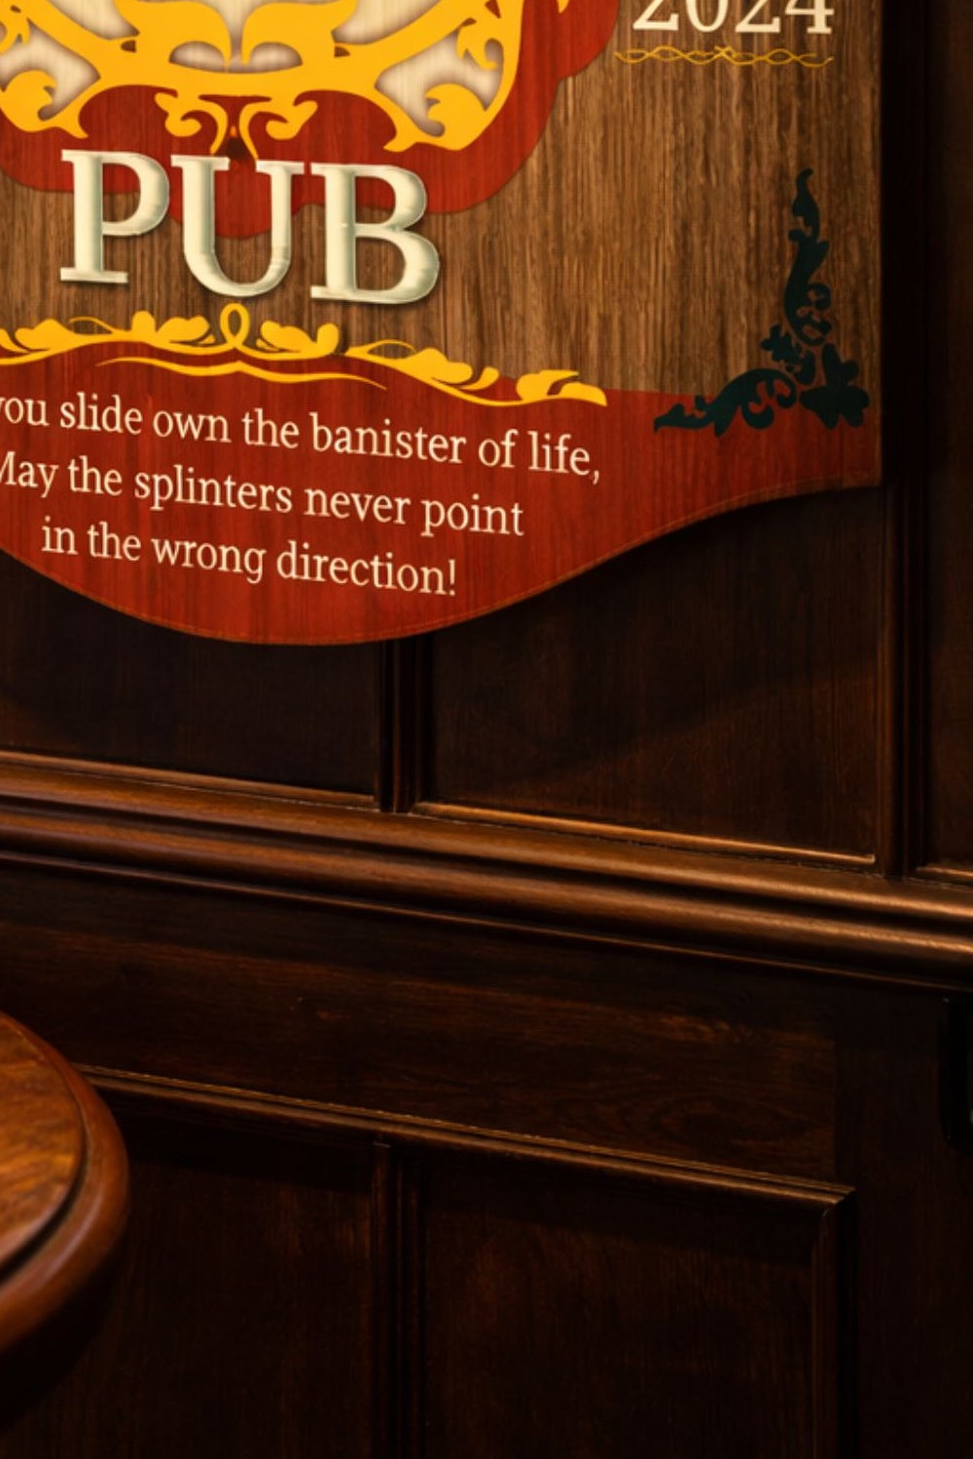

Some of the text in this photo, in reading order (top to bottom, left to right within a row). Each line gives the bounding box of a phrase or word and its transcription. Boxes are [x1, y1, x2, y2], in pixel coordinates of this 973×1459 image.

[59, 148, 440, 305] PUB
[59, 391, 143, 435] slide
[152, 410, 231, 443] own
[241, 407, 300, 449] the
[309, 411, 467, 464] banister
[478, 428, 520, 468] of
[527, 430, 600, 484] life,
[67, 454, 123, 496] the
[134, 464, 293, 513] splinters
[304, 488, 412, 525] never
[421, 493, 525, 537] point
[41, 515, 456, 596] in the wrong direction!
